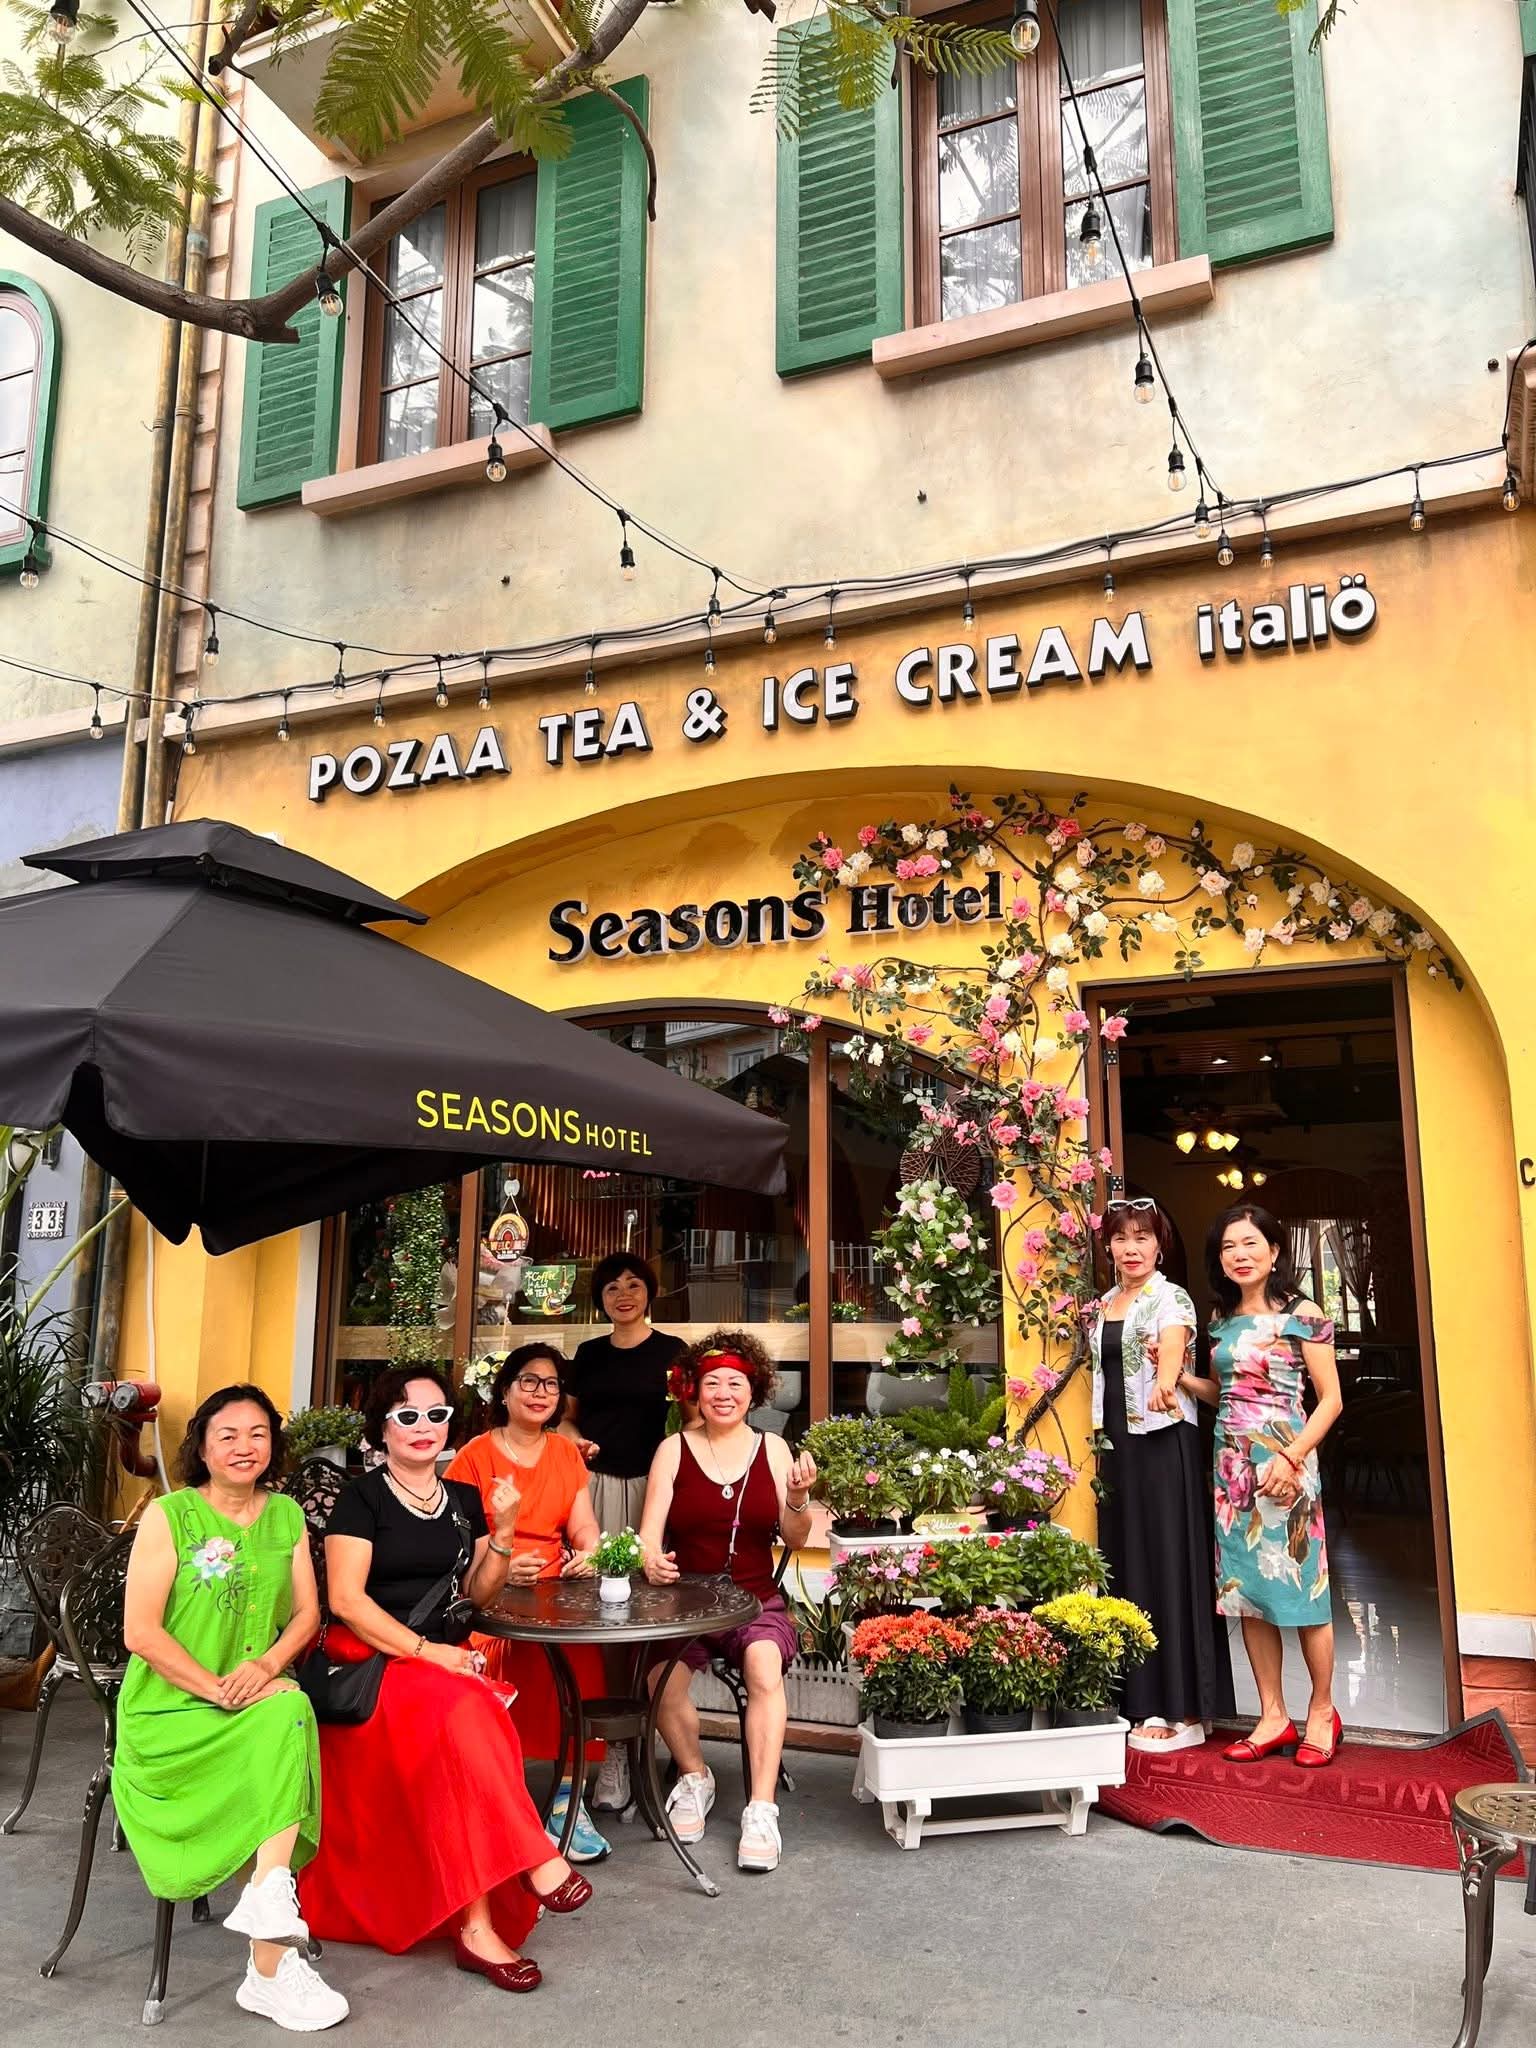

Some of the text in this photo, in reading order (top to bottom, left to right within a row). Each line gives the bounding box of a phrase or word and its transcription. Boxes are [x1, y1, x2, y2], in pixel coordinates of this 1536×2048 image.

[308, 573, 1377, 802] POZAA TEA & ICE CREAM italiö
[548, 870, 1005, 964] Seasons Hotel
[416, 1089, 652, 1155] SEASONS HOTEL
[597, 1176, 678, 1194] WELCME
[34, 1210, 57, 1230] 33
[1149, 1754, 1451, 1817] WELCOME
